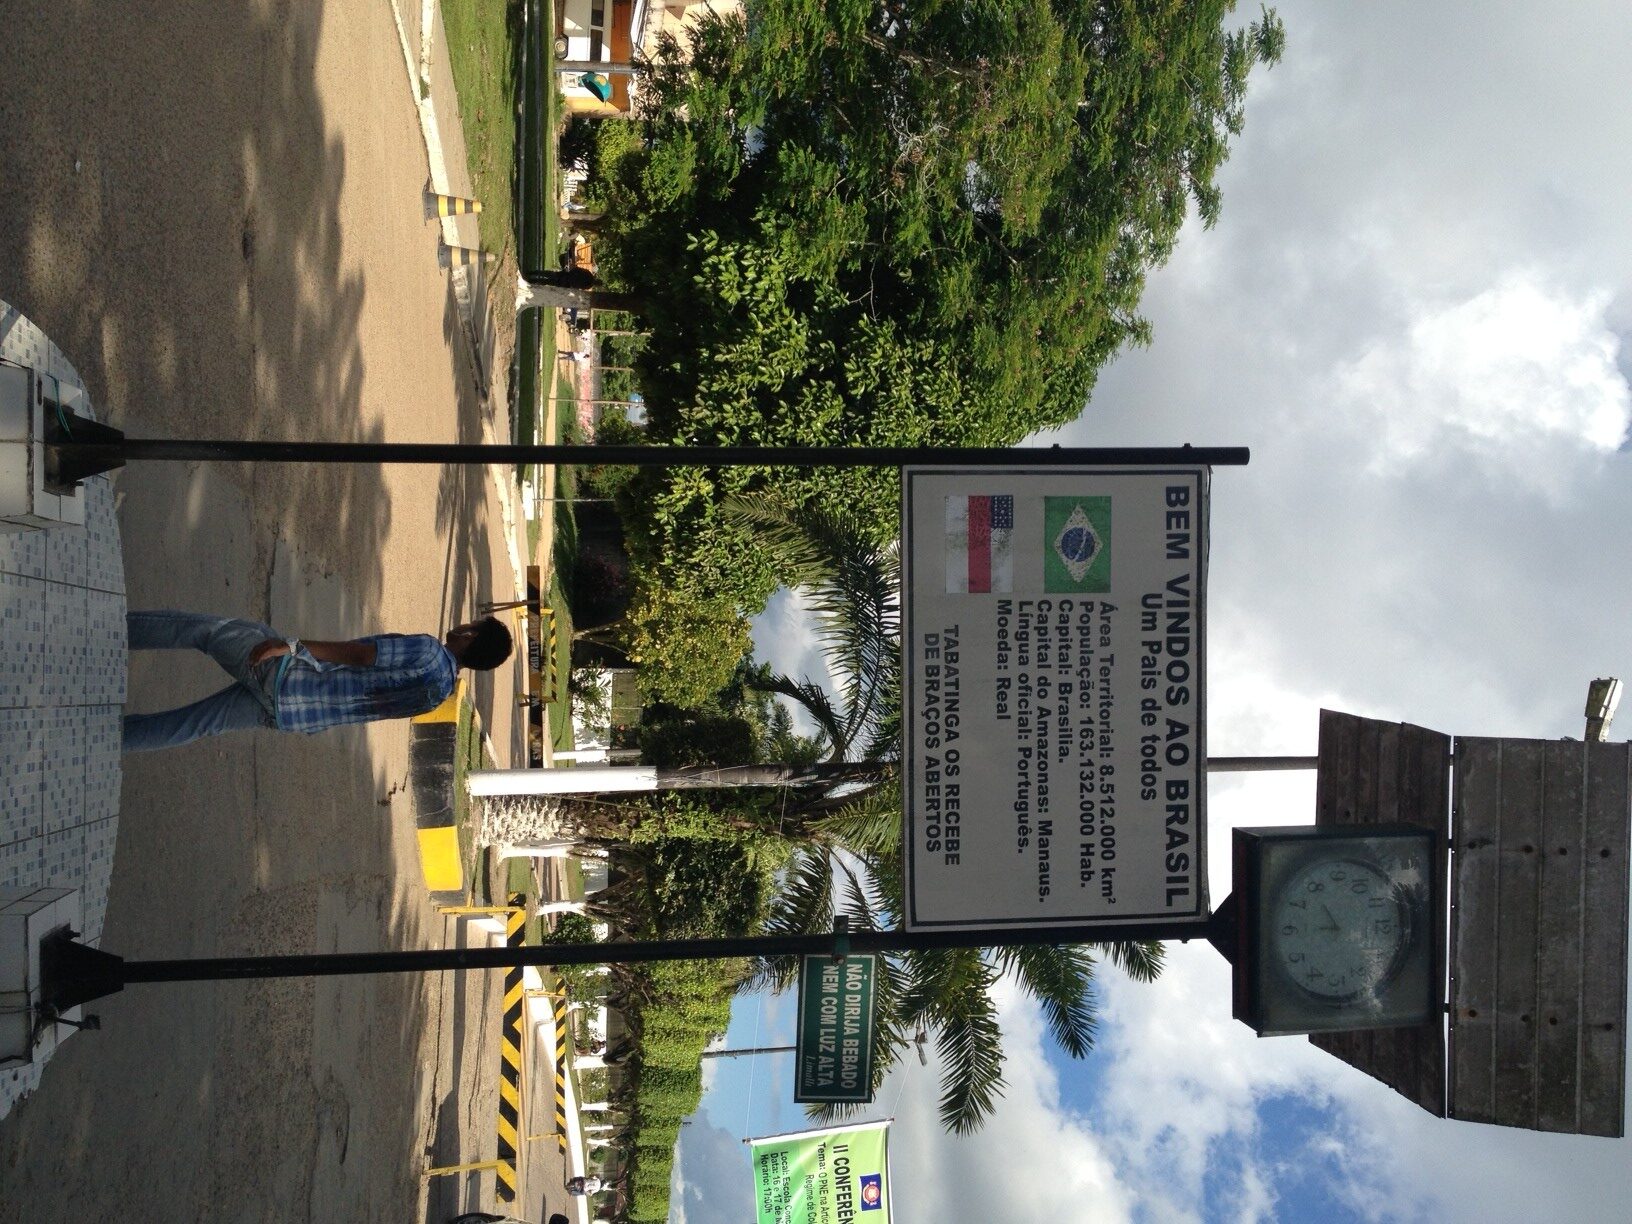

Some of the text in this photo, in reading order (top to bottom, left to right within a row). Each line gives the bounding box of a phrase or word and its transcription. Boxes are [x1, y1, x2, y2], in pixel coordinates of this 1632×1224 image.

[531, 615, 540, 674] PREFEITURA
[996, 600, 1012, 719] Moeda: Real
[1055, 599, 1073, 763] Capital: Brasilia.
[1140, 594, 1162, 800] Um Pais de todos
[1166, 486, 1190, 906] BEM VINDOS AO BRASIL
[1014, 601, 1033, 853] Língua oficial: Português.
[921, 633, 941, 852] DE BRAÇOS ABERTOS
[944, 624, 960, 866] TABATINGA OS RECEBE
[1034, 600, 1052, 902] Capital do Amazonas: Manaus.
[1076, 601, 1095, 887] População: 163.132.000 Hab.
[1099, 601, 1118, 904] Área Territorial: 8.512.000 km²
[1330, 871, 1346, 881] 9
[1307, 882, 1324, 893] 8
[1351, 879, 1368, 894] 10
[1289, 900, 1306, 910] 7
[1368, 898, 1385, 908] 11
[1282, 925, 1298, 936] 6
[1374, 919, 1391, 935] 12
[1289, 952, 1304, 963] 5
[1307, 966, 1324, 982] 4
[1328, 975, 1345, 986] 3
[1351, 966, 1366, 977] 2
[817, 966, 839, 1086] NEM COM LUZ ALTA
[840, 964, 867, 1089] NÃO DIRIJA BEBADO
[818, 1142, 826, 1170] Tema:
[833, 1144, 848, 1153] II
[770, 1153, 779, 1173] Data:
[781, 1151, 790, 1175] Local:
[761, 1154, 772, 1213] Horário: 17:00h
[773, 1176, 780, 1185] 16
[804, 1174, 814, 1200] Regime
[819, 1180, 828, 1195] PNE
[774, 1194, 782, 1202] 17
[783, 1177, 792, 1203] Escola
[807, 1202, 816, 1210] de
[820, 1197, 826, 1205] na
[774, 1206, 782, 1215] de
[820, 1207, 830, 1224] Artic
